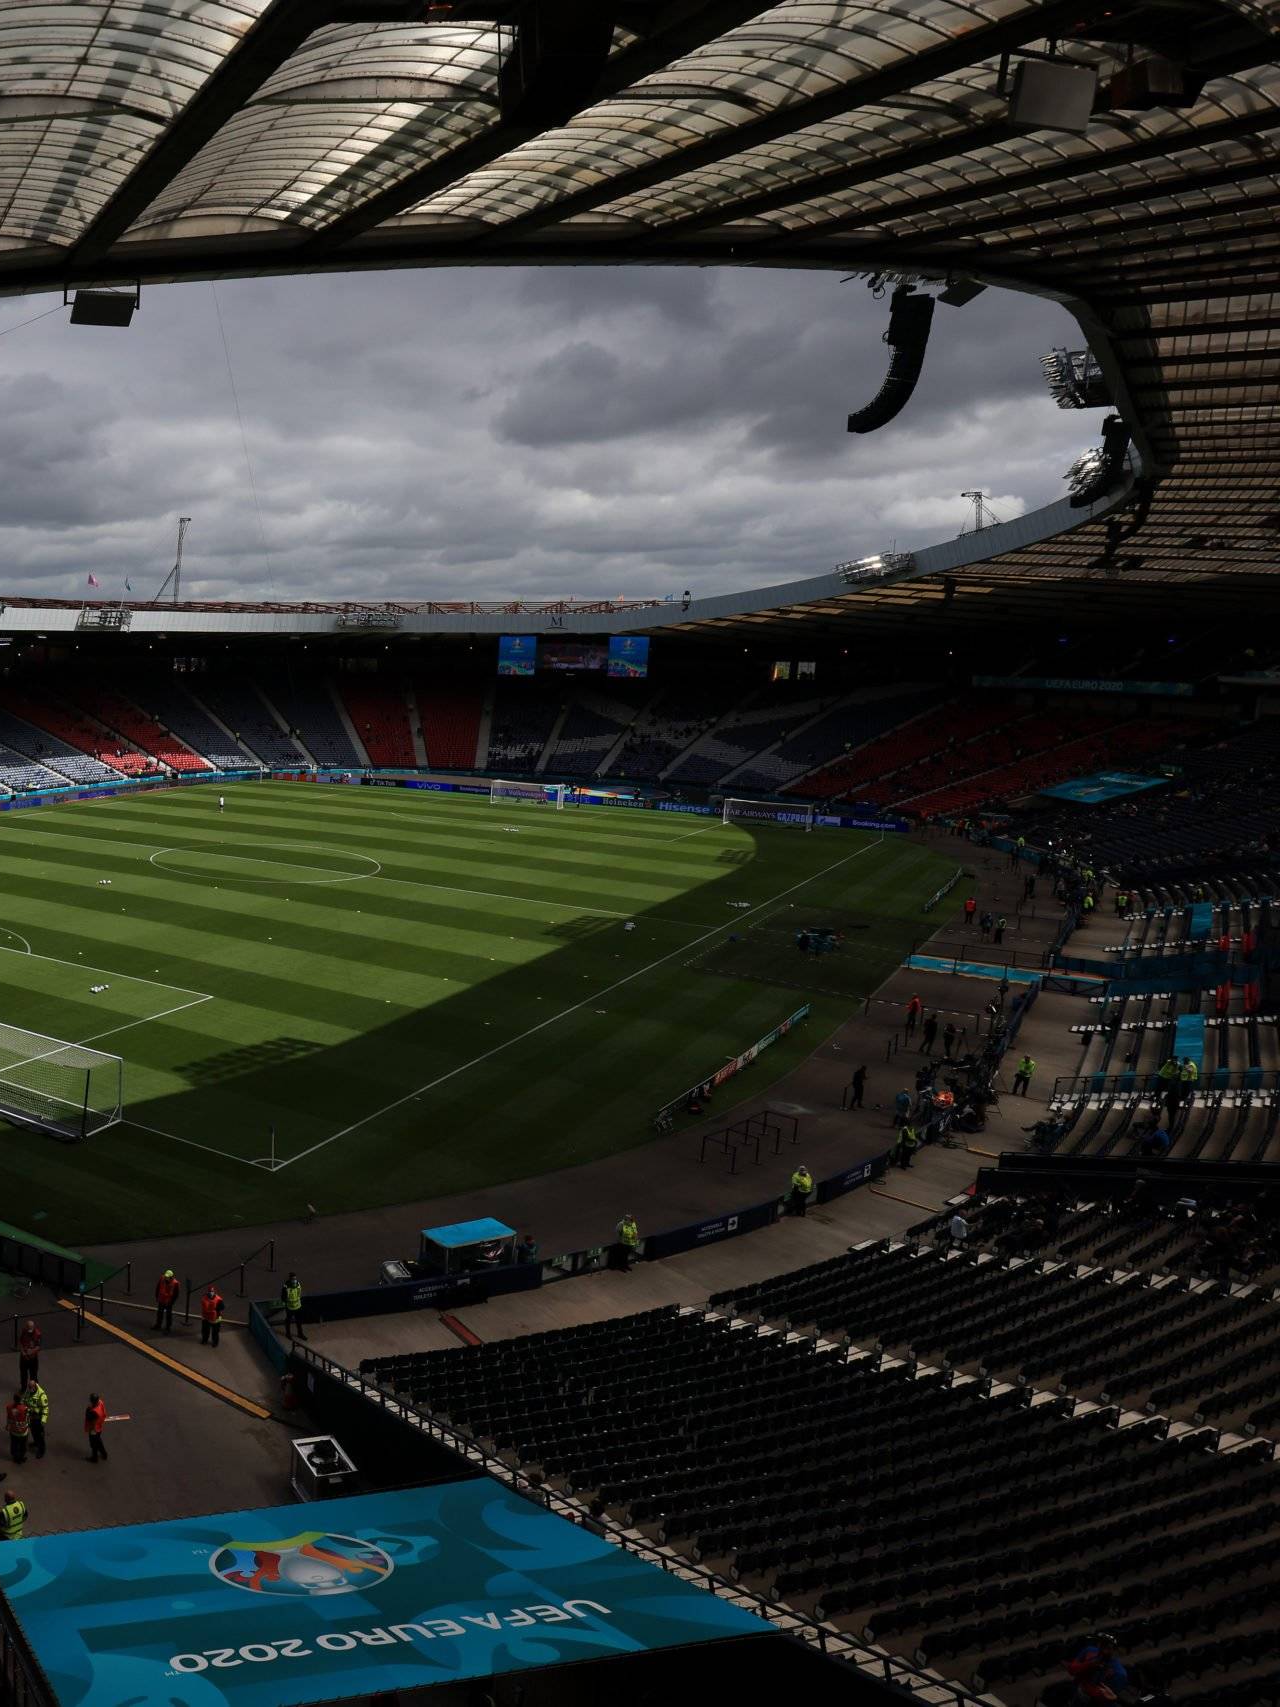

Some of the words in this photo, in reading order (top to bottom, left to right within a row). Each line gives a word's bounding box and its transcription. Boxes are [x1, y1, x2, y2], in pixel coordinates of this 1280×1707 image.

[602, 797, 645, 808] Heineken
[658, 801, 711, 814] Hisense
[852, 819, 896, 829] Booking.com
[461, 1599, 613, 1630] UEFA
[315, 1619, 467, 1651] EURO
[169, 1638, 313, 1673] 2020
